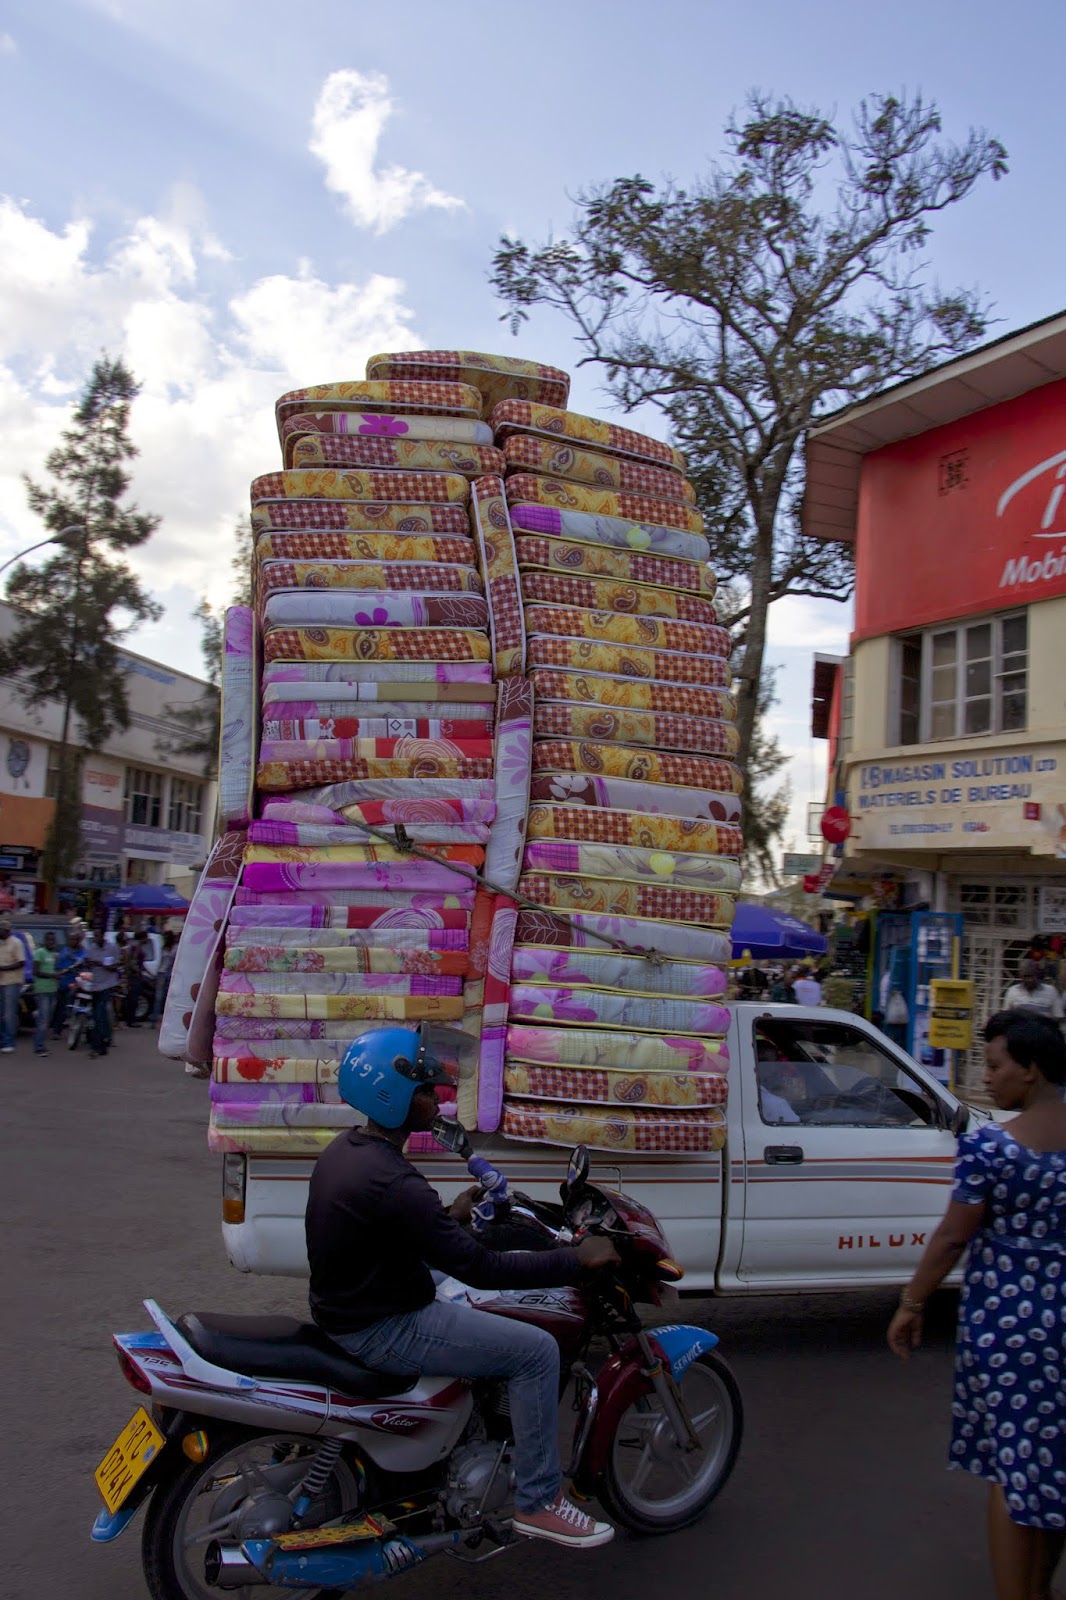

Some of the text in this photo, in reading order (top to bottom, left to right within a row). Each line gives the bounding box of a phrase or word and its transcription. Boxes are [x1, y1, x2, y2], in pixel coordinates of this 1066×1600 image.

[881, 763, 946, 785] MAGASIN
[952, 755, 1033, 778] SOLUTION
[1035, 759, 1057, 772] LTD
[859, 784, 1032, 809] MATERIELS DE BUREAU
[343, 1051, 385, 1086] 1497
[838, 1233, 926, 1249] HILUX
[518, 1294, 572, 1312] GLX
[673, 1341, 704, 1373] SERVICE
[373, 1413, 420, 1427] Victor
[125, 1420, 153, 1461] RC
